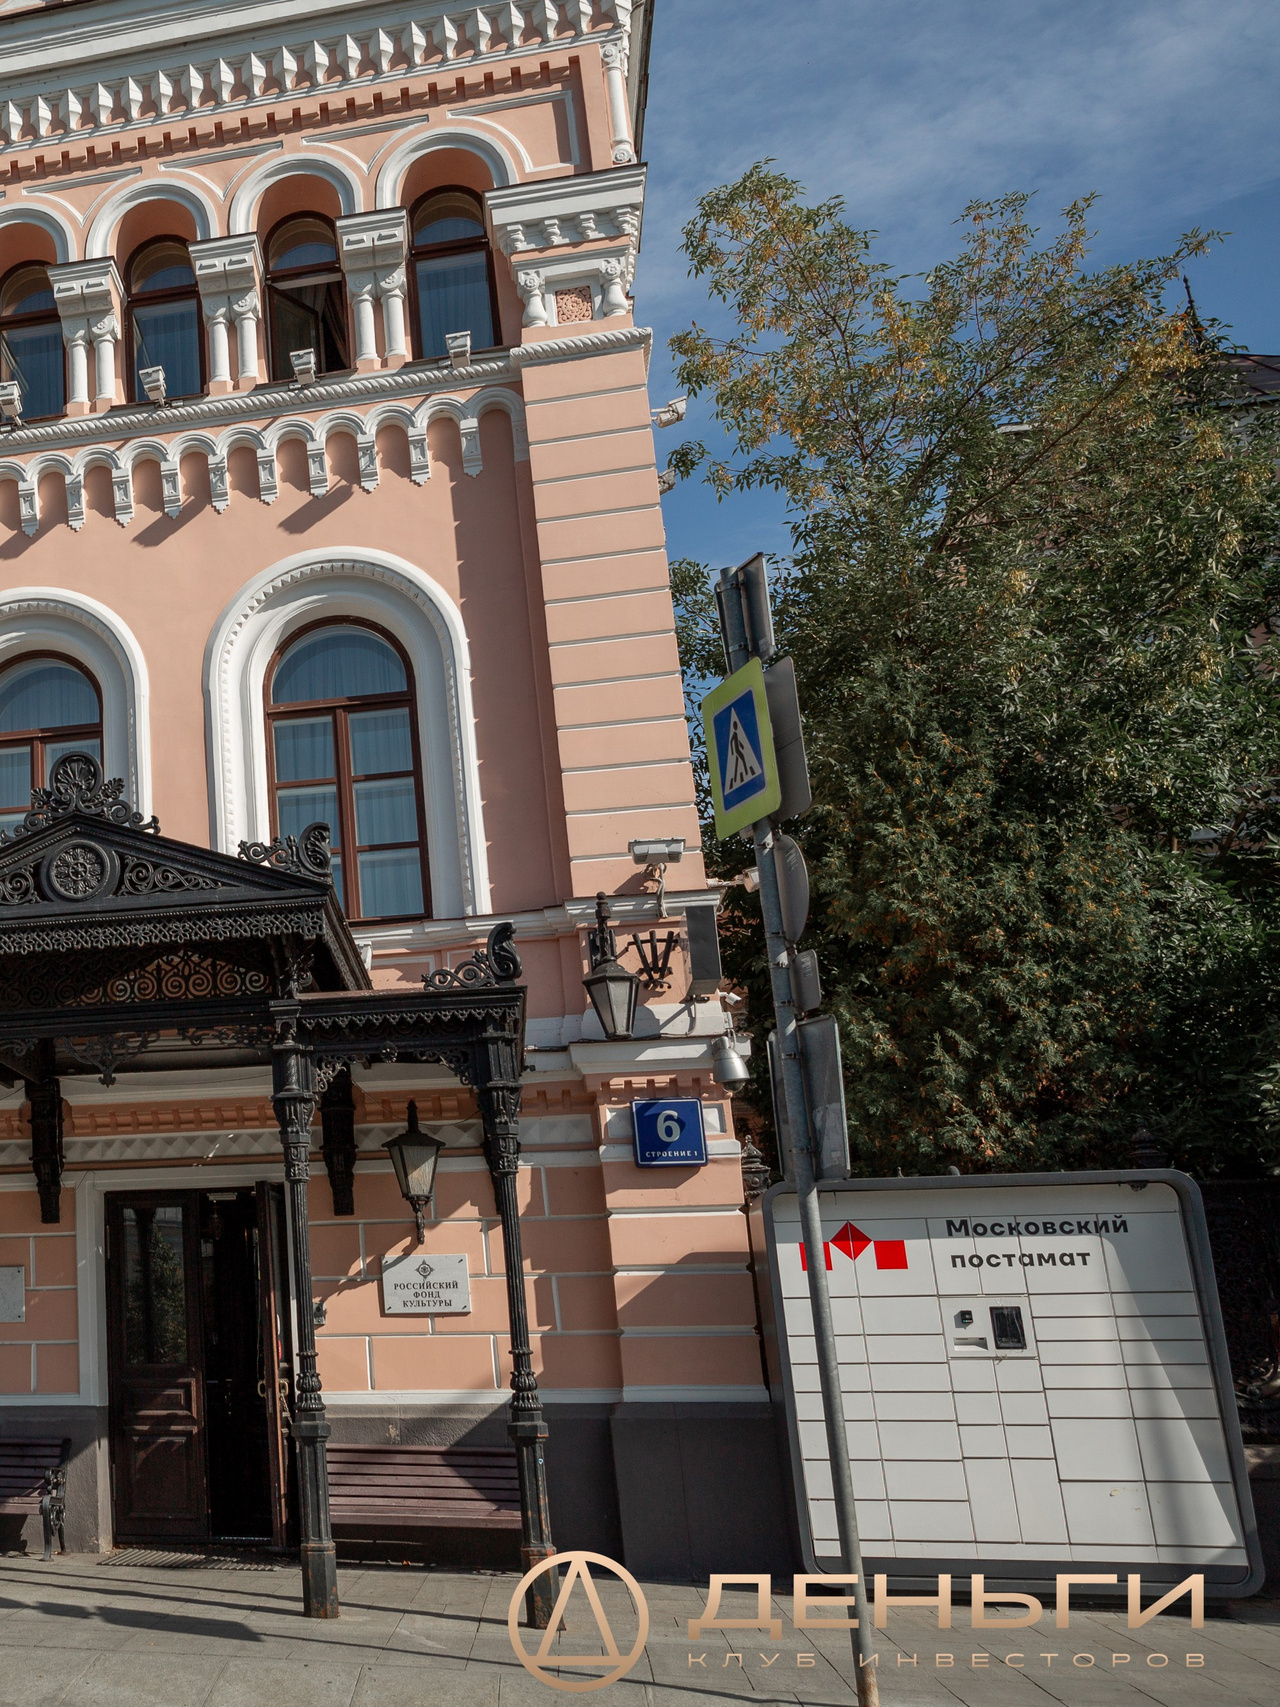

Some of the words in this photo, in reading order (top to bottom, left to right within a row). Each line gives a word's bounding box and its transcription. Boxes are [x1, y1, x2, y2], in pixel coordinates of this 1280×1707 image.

[657, 1110, 680, 1142] 6
[945, 1214, 1129, 1237] Московский
[950, 1251, 1091, 1268] постамат
[394, 1280, 458, 1290] РОССИЙСКИЙ
[413, 1291, 440, 1299] ФОНД
[403, 1299, 452, 1308] КУЛЬТУРЫ
